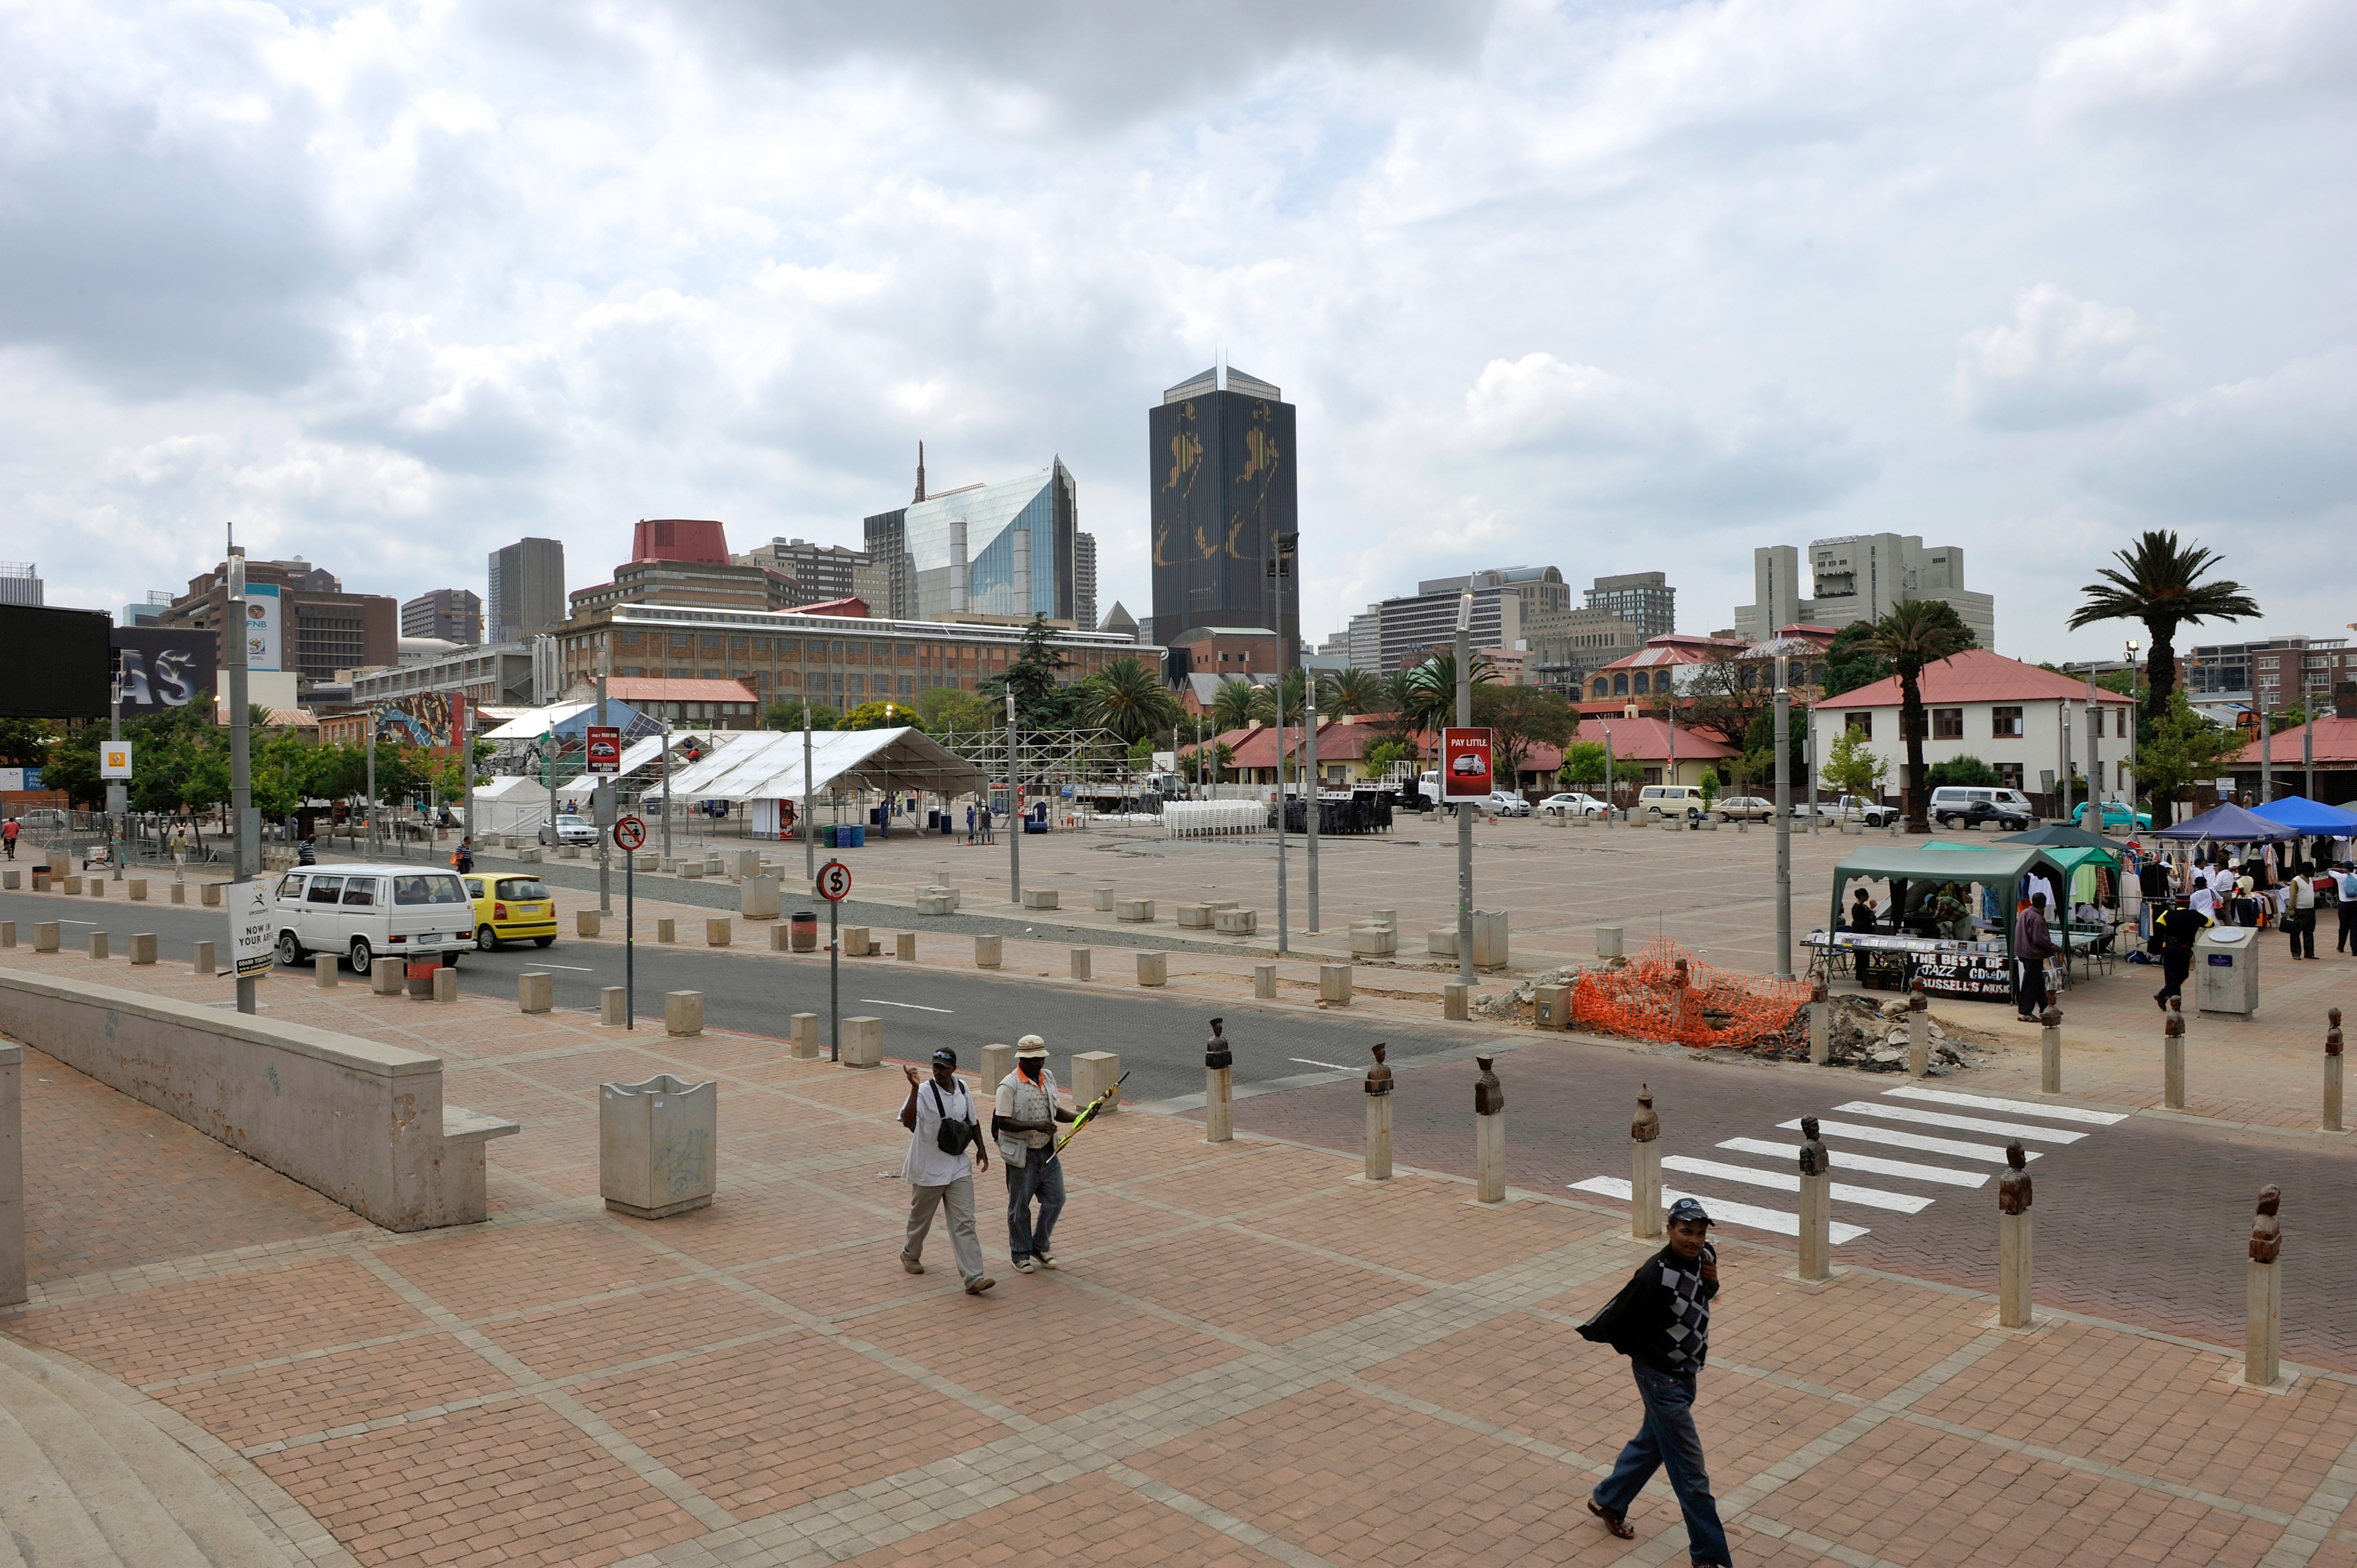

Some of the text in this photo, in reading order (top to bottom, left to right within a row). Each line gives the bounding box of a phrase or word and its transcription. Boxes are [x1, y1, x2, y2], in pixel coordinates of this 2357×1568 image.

[246, 923, 270, 935] NOW IN
[239, 935, 261, 946] YOUR
[1911, 953, 2003, 969] THE BEST OF
[1921, 964, 1956, 977] JAZZ
[1983, 983, 2010, 994] MUSIC
